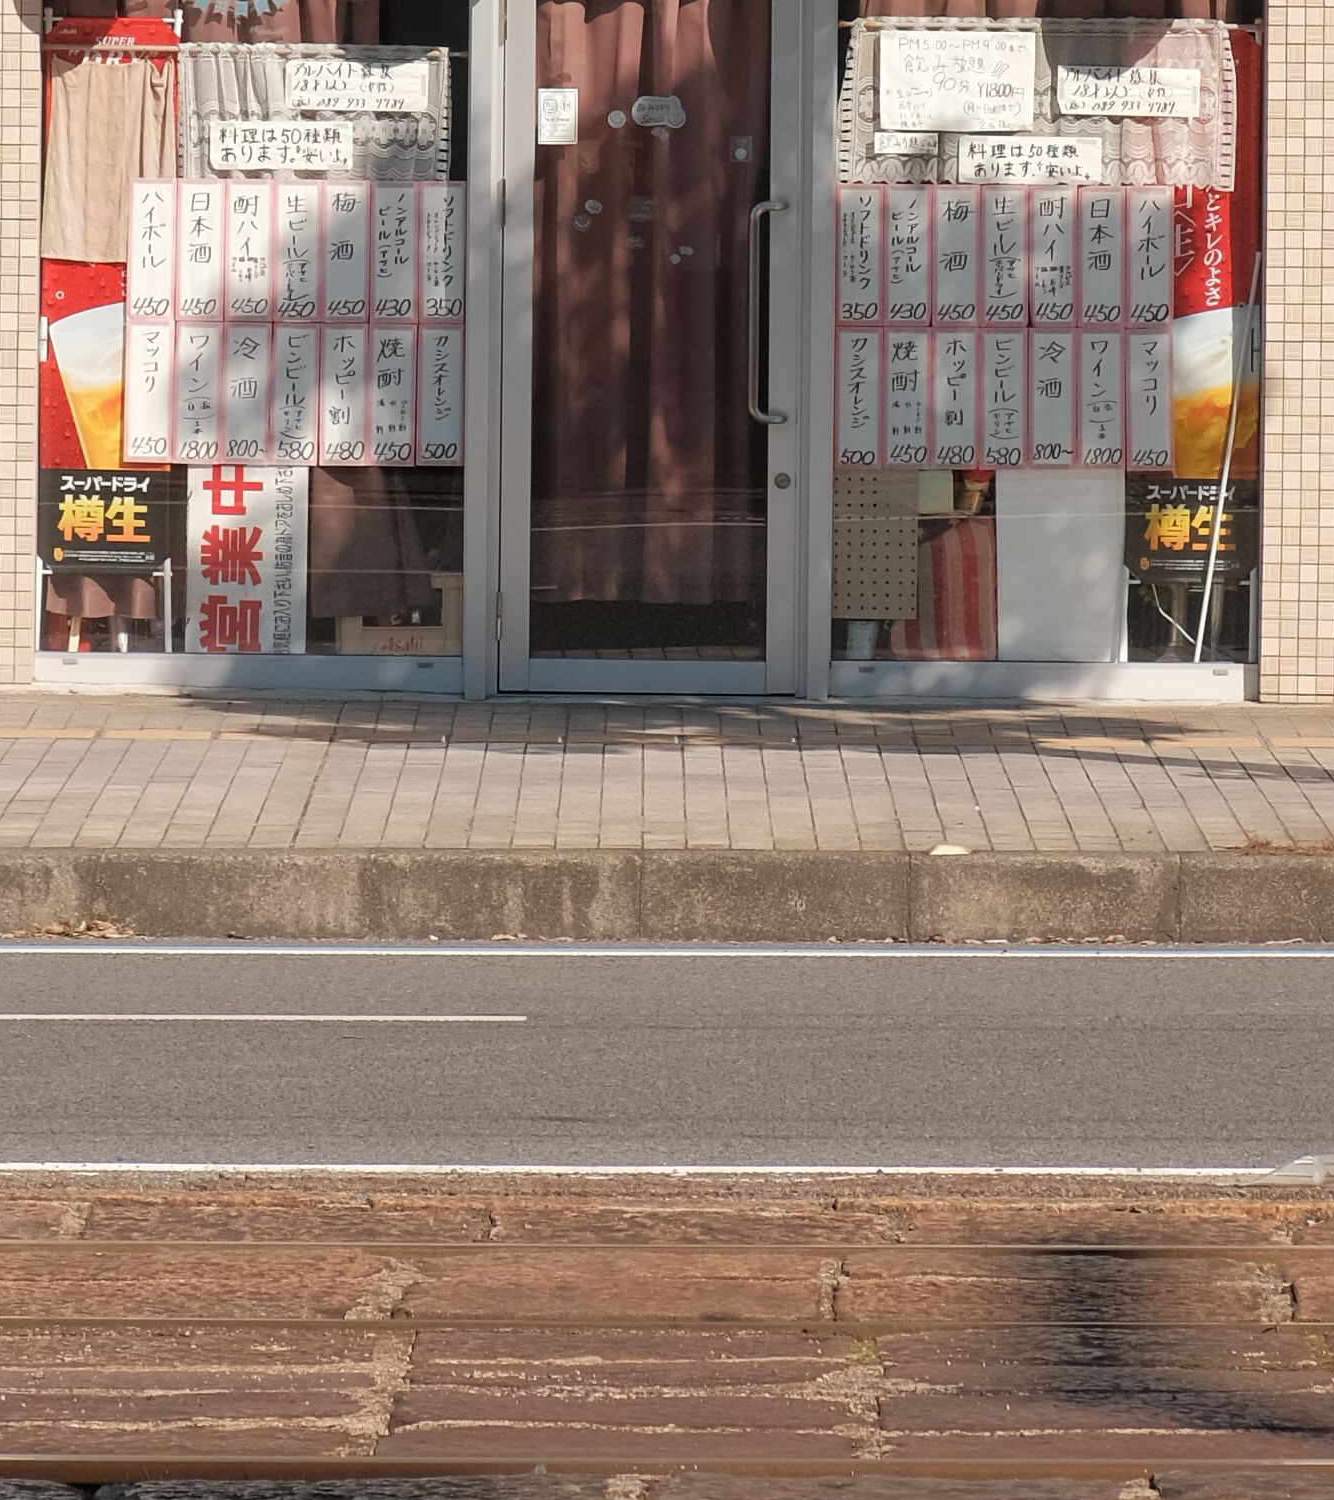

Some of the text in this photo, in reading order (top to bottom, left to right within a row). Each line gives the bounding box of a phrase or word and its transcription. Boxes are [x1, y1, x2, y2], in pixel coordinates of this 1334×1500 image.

[219, 127, 342, 145] 料理は50種類
[967, 141, 1079, 159] 料理は50種類
[141, 192, 167, 269] ハイボール
[189, 192, 213, 263] 日本酒
[233, 194, 260, 257] 酎ハイ
[285, 195, 309, 260] 生ビール
[330, 192, 361, 261] 梅酒
[394, 193, 409, 265] ノンアルコール
[441, 195, 455, 287] ソフトドリンク
[859, 195, 872, 290] ソフトドリンク
[905, 198, 922, 273] ノンアルコール
[939, 199, 974, 272] 梅酒
[992, 196, 1016, 256] 生ビール
[1039, 196, 1067, 262] 酎ハイ
[1088, 198, 1114, 271] 日本酒
[1137, 200, 1166, 280] ハイボール
[1203, 186, 1224, 307] とキレのよさ
[133, 297, 170, 316] 450
[181, 298, 217, 315] 450
[232, 297, 268, 315] 450
[278, 300, 316, 318] 450
[328, 300, 365, 316] 450
[376, 299, 412, 317] 430
[426, 298, 462, 317] 350
[842, 302, 878, 320] 350
[889, 302, 927, 320] 430
[937, 303, 975, 320] 450
[986, 303, 1024, 321] 450
[1035, 302, 1073, 321] 450
[1083, 304, 1121, 322] 450
[1131, 303, 1169, 322] 450
[141, 331, 160, 394] マッコリ
[187, 335, 209, 393] ワイン
[231, 336, 261, 399] 冷酒
[285, 334, 309, 406] ビンビール
[328, 335, 356, 425] ホッピー割
[377, 336, 406, 389] 焼酎
[431, 335, 452, 421] カシスオレンジ
[848, 337, 869, 429] カシスオレンジ
[891, 340, 920, 392] 焼酎
[944, 338, 967, 426] ホッピー割
[994, 338, 1016, 403] ビンビール
[1037, 341, 1066, 399] 冷酒
[1090, 339, 1109, 398] ワイン
[1141, 341, 1159, 416] マッコリ
[131, 436, 167, 455] 450
[277, 440, 315, 460] 580
[327, 440, 365, 460] 480
[373, 443, 412, 461] 450
[422, 442, 458, 460] 500
[840, 449, 875, 465] 500
[889, 444, 927, 464] 450
[937, 445, 975, 465] 480
[986, 446, 1021, 466] 580
[1133, 450, 1168, 467] 450
[59, 475, 151, 493] スーパードライ
[56, 493, 151, 543] 樽生
[1143, 503, 1237, 551] 樽生
